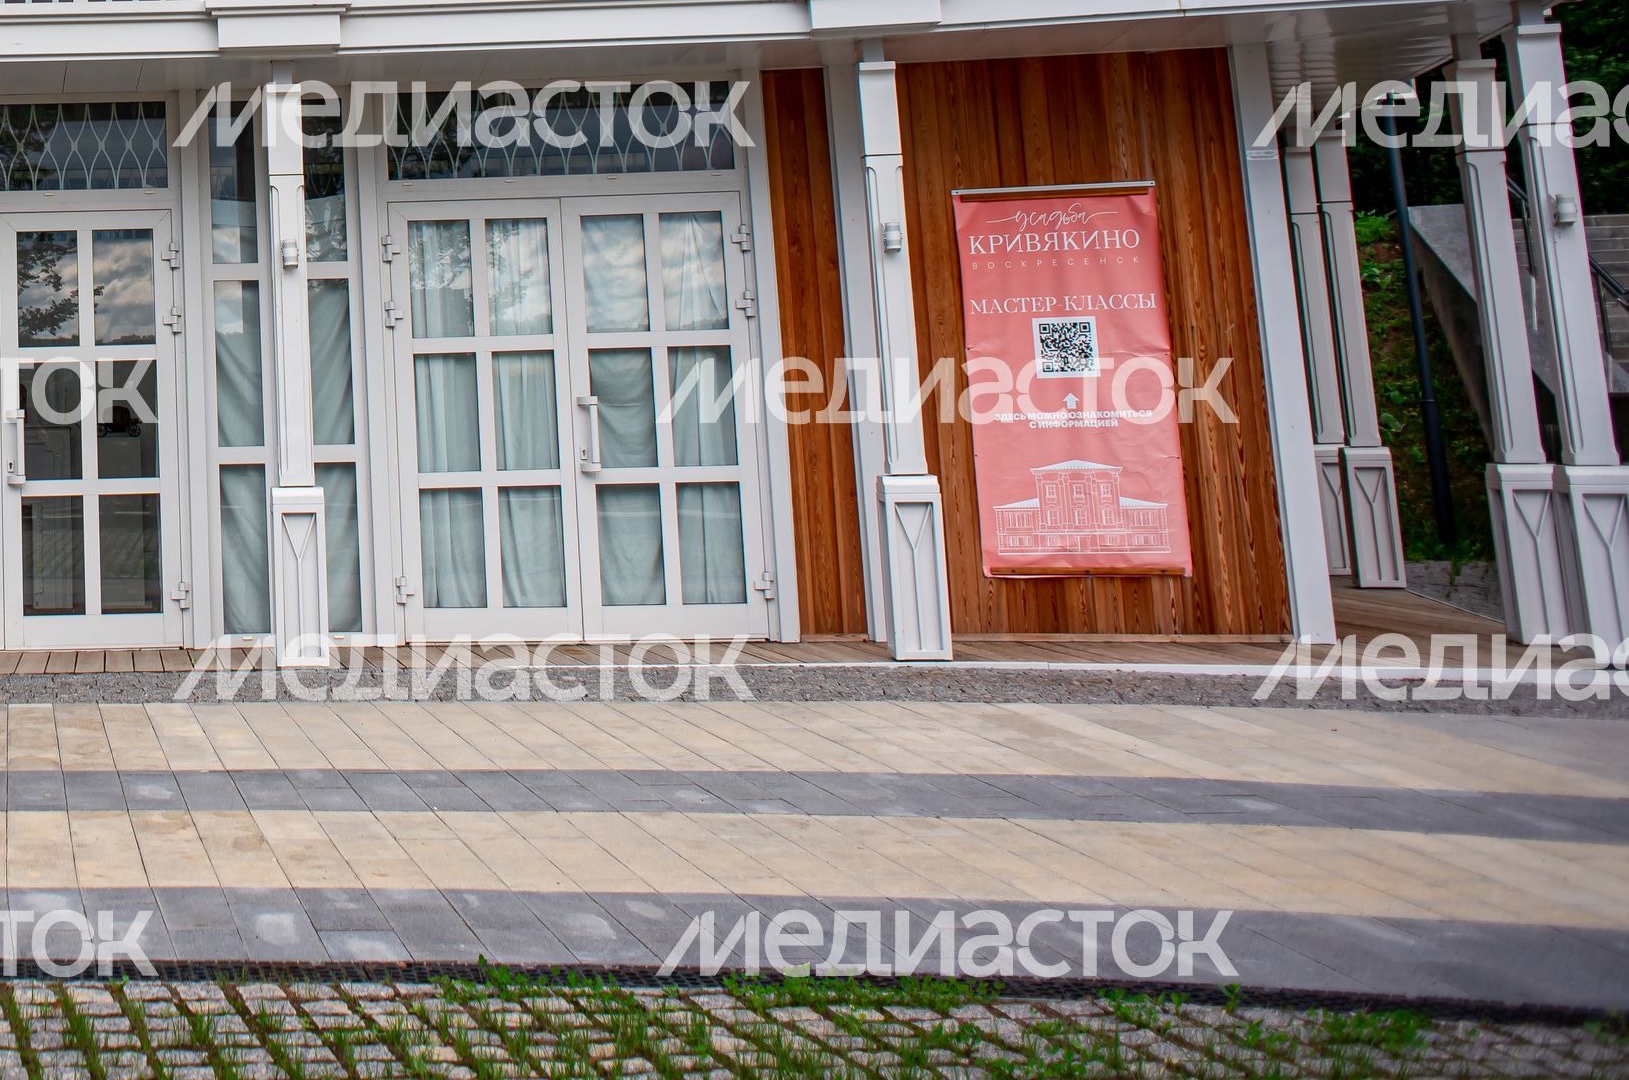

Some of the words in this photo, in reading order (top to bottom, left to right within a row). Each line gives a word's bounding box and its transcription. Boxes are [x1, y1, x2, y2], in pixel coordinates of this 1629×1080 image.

[969, 228, 1140, 255] КРИВЯКИНО
[972, 256, 1139, 270] ВОСКРЕСЕНСК
[970, 293, 1157, 315] МАСТЕР-КЛАССЫ
[995, 413, 1026, 423] ЗДЕСЬ
[1028, 411, 1067, 421] МОЖНО
[1070, 409, 1153, 420] ОЗНАКОМИТЬСЯ
[1038, 419, 1119, 429] ИНФОРМАЦИЕЙ
